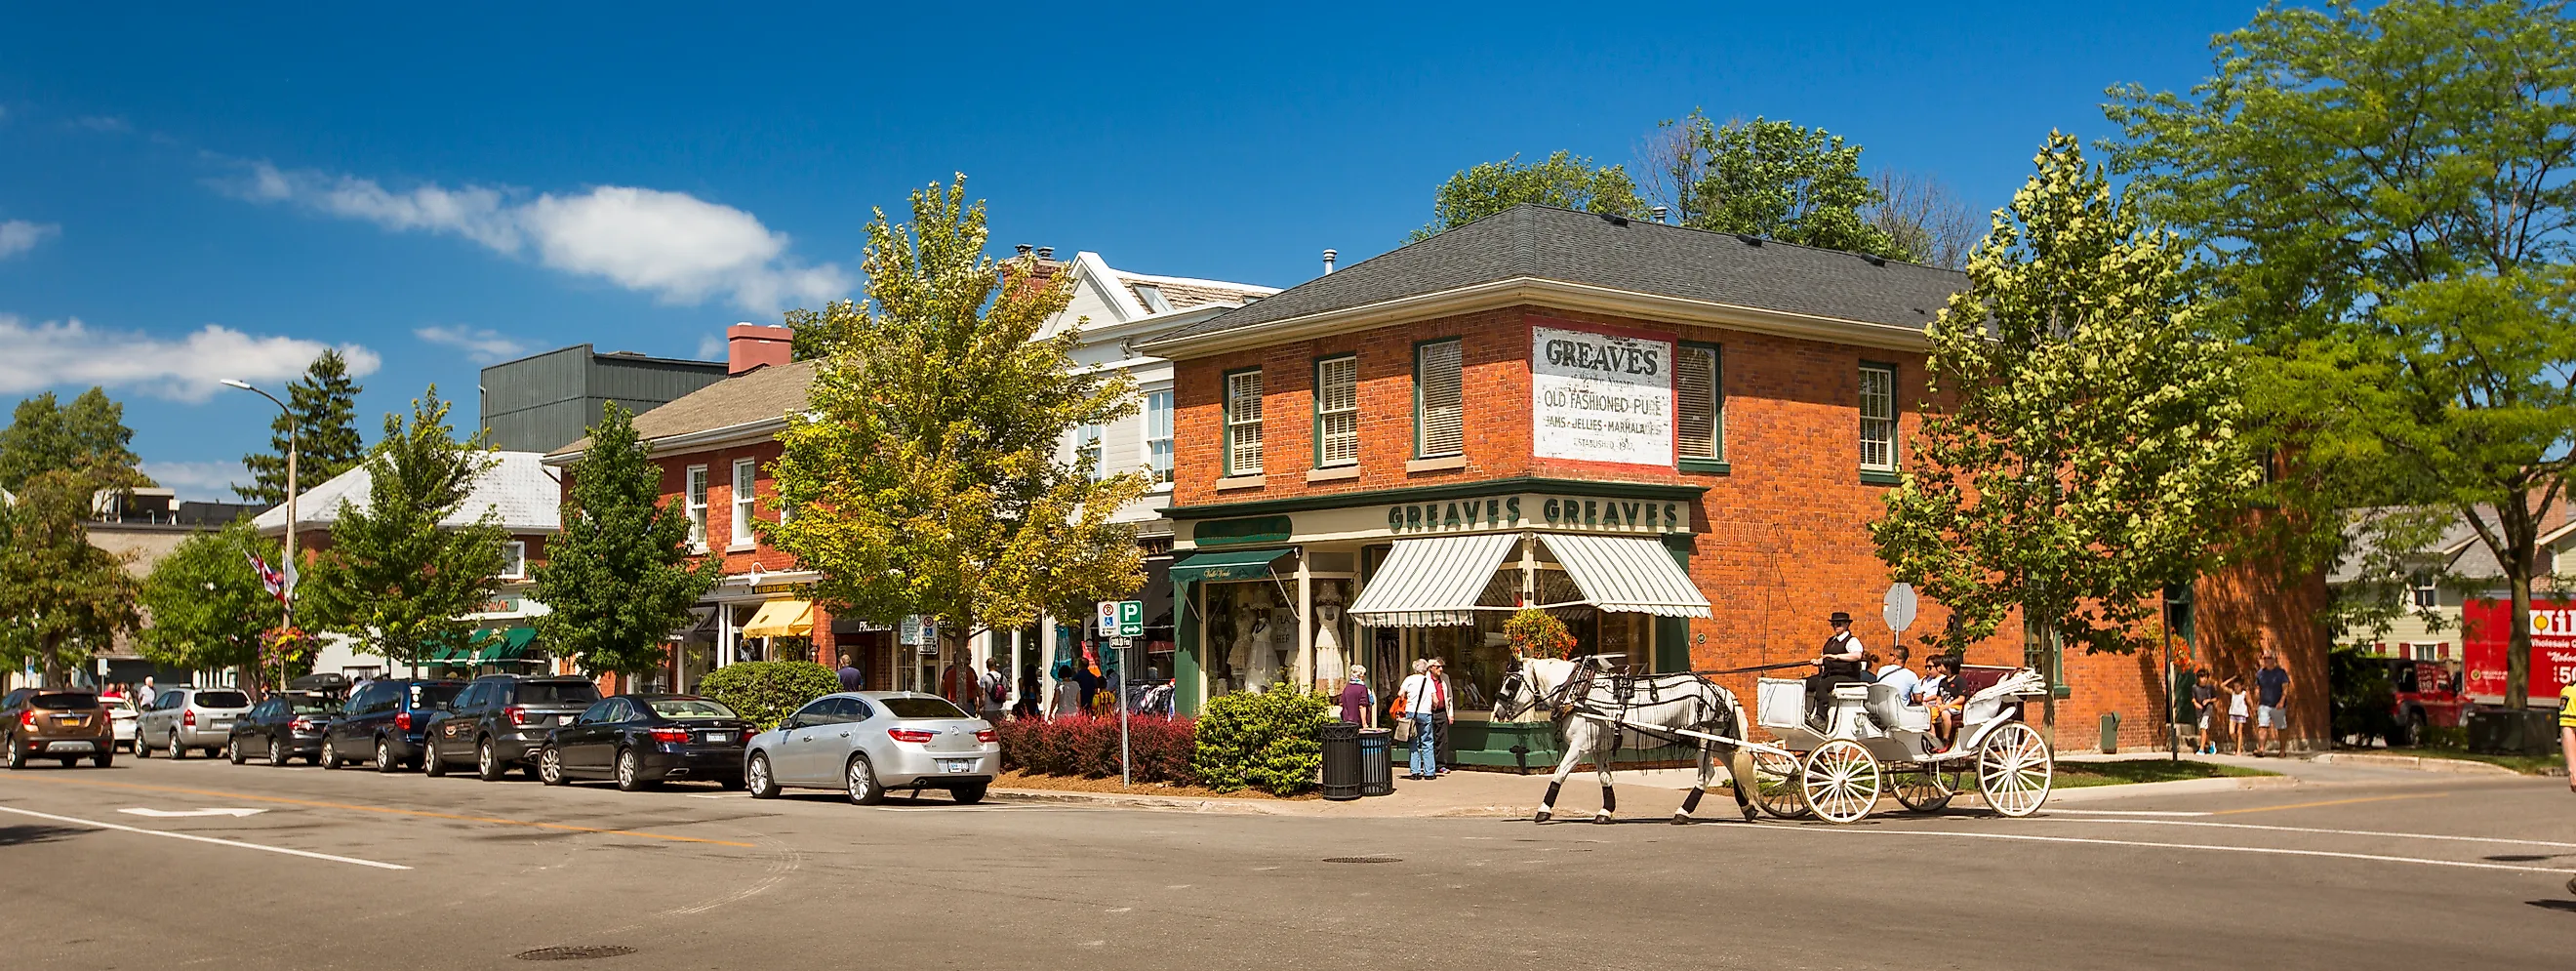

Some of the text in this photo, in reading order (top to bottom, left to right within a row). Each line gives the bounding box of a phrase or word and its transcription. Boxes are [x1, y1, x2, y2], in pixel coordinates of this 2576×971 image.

[1546, 340, 1658, 376] GREAVES
[1544, 390, 1566, 408] OLD
[1570, 392, 1629, 413] FASHIONED
[1545, 416, 1566, 428] JAMS
[1572, 418, 1603, 431] JELLIES
[1388, 497, 1521, 530] GREAVES
[1543, 498, 1677, 527] GREAVES
[1124, 604, 1139, 622] P
